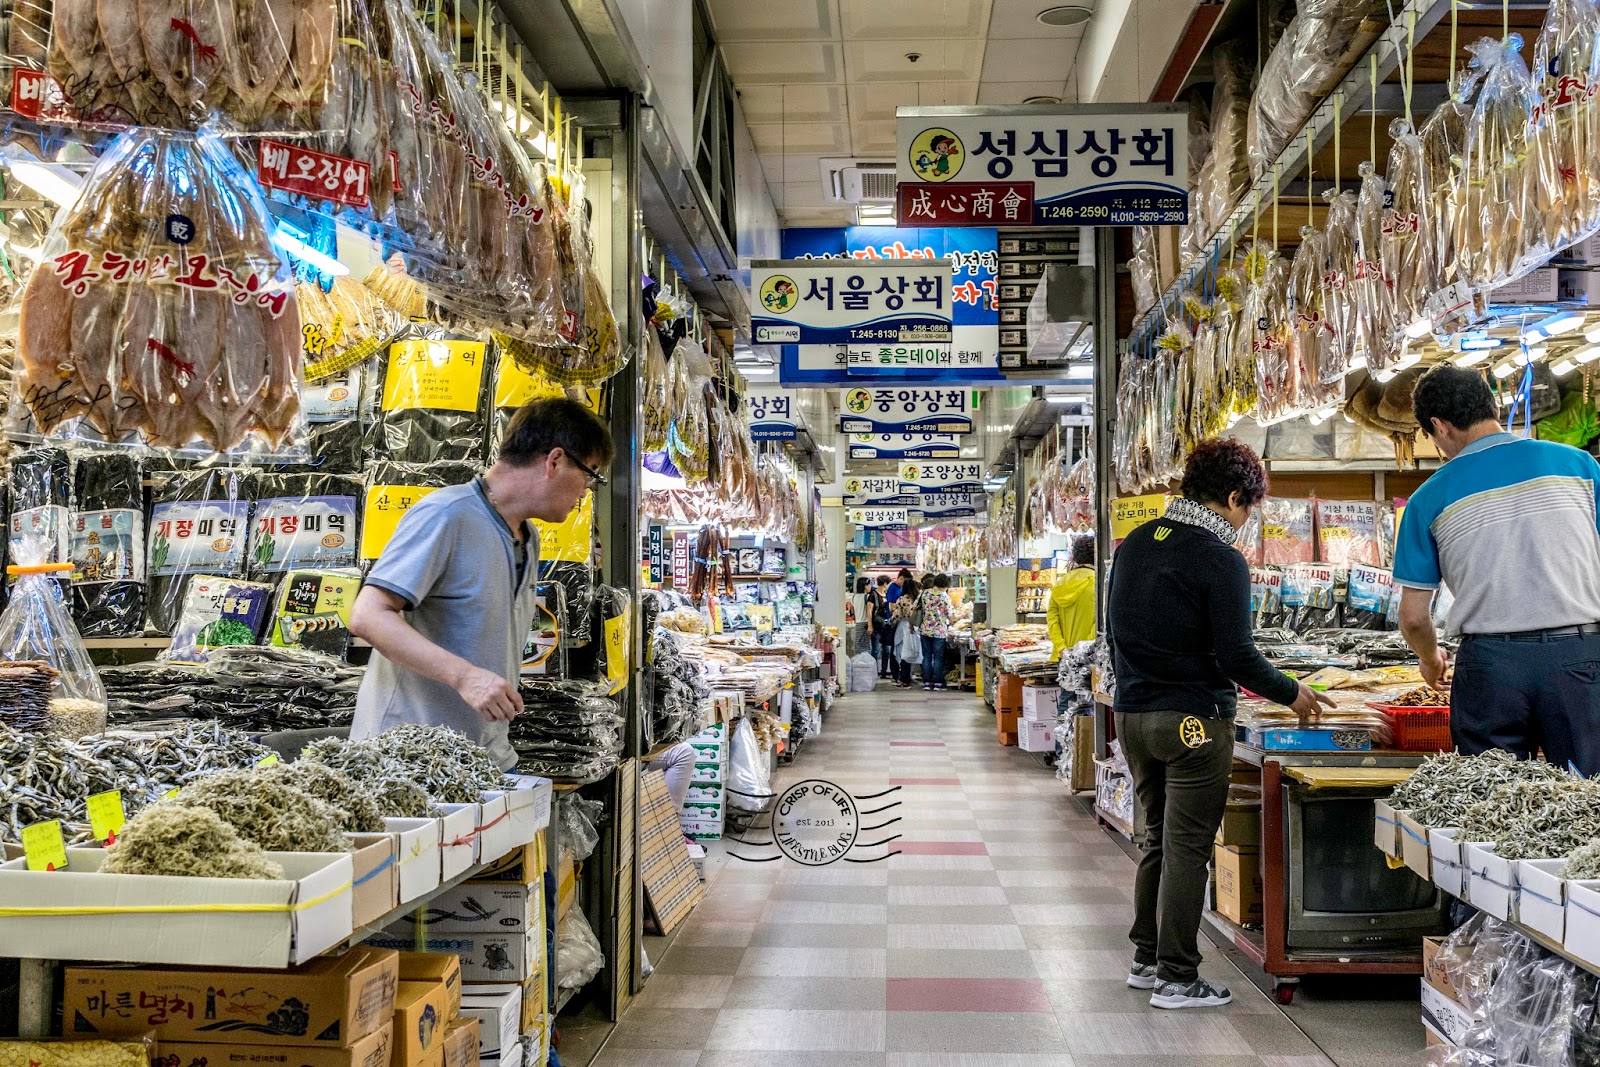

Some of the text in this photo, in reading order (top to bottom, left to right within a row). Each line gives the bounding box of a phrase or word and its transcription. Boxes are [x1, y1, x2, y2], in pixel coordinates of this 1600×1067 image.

[970, 127, 1174, 179] 성심상회
[262, 146, 366, 197] 배오징어
[908, 187, 1025, 220] 成心商會
[1040, 206, 1109, 218] T.246-2590
[1110, 211, 1185, 223] H.010-5679-2590
[803, 275, 943, 311] 서울상회
[850, 329, 898, 339] T.245-8130
[834, 350, 872, 365] 오늘도
[958, 351, 983, 364] 함께
[873, 390, 966, 413] 중앙상회
[905, 424, 937, 432] T.245-5720
[920, 464, 981, 480] 조양상회
[862, 479, 900, 493] 자갈치
[924, 494, 972, 506] 일성상회
[864, 511, 906, 522] 일성상회
[1116, 508, 1158, 520] 산모미역
[1324, 505, 1342, 513] 기장
[1357, 515, 1374, 524] 미역
[650, 530, 661, 579] 기장미역
[675, 538, 687, 577] 산모미역
[1355, 569, 1377, 584] 기장
[86, 989, 194, 1026] 마른 멸치
